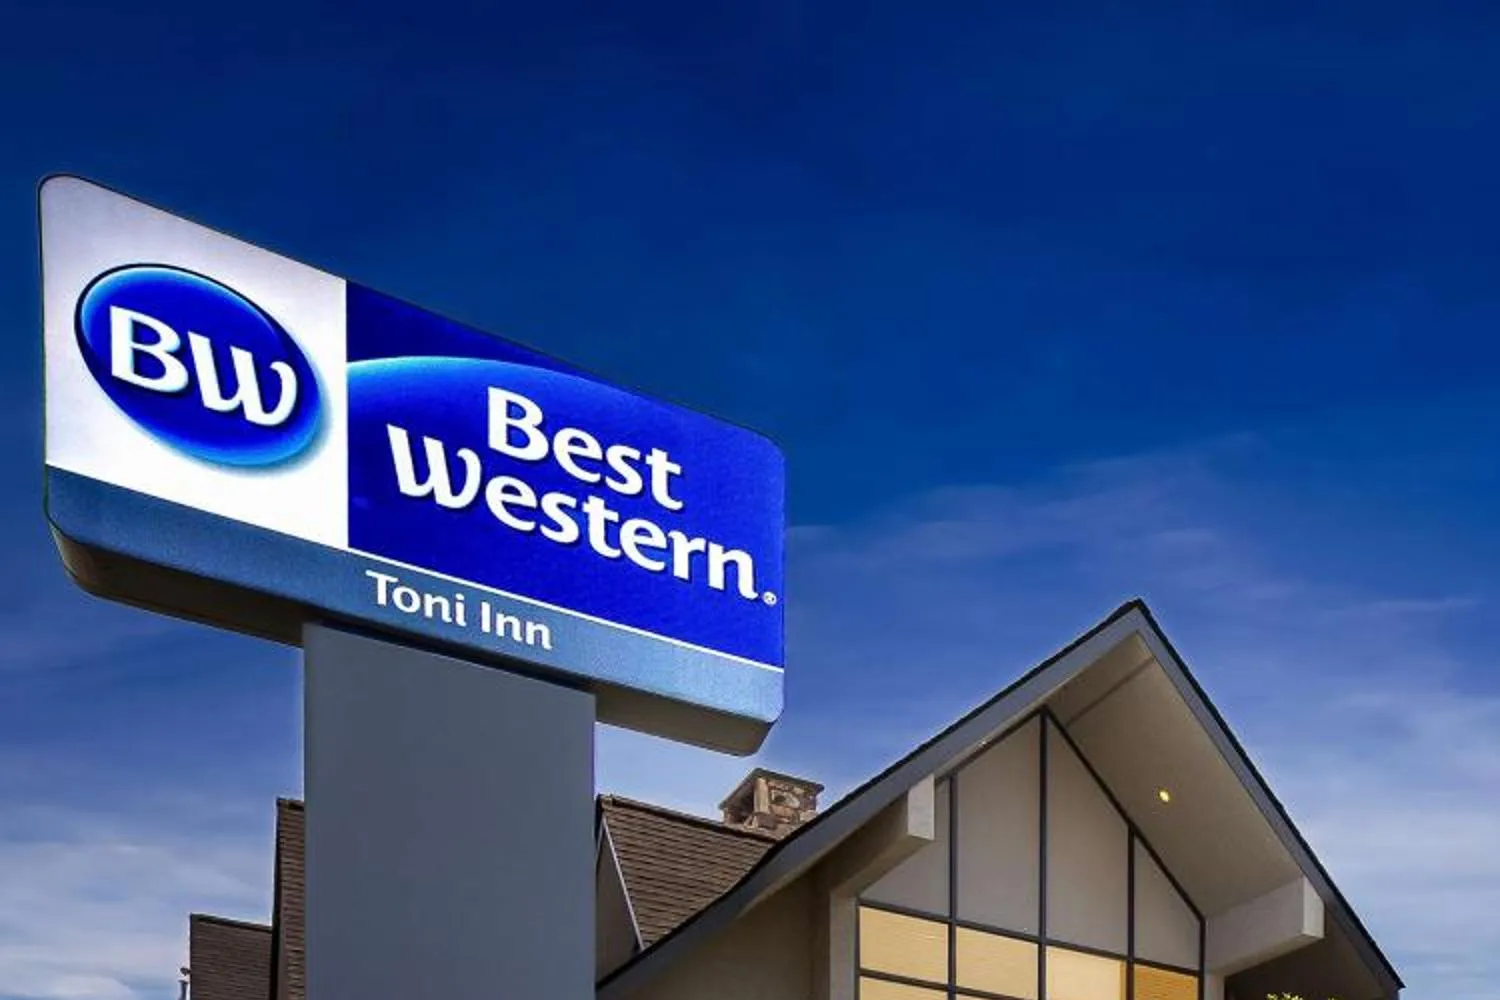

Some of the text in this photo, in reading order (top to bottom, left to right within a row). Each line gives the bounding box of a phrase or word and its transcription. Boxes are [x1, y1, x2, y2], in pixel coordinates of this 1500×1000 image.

[110, 305, 298, 427] BW
[487, 386, 683, 510] Best
[365, 569, 553, 651] Toni Inn
